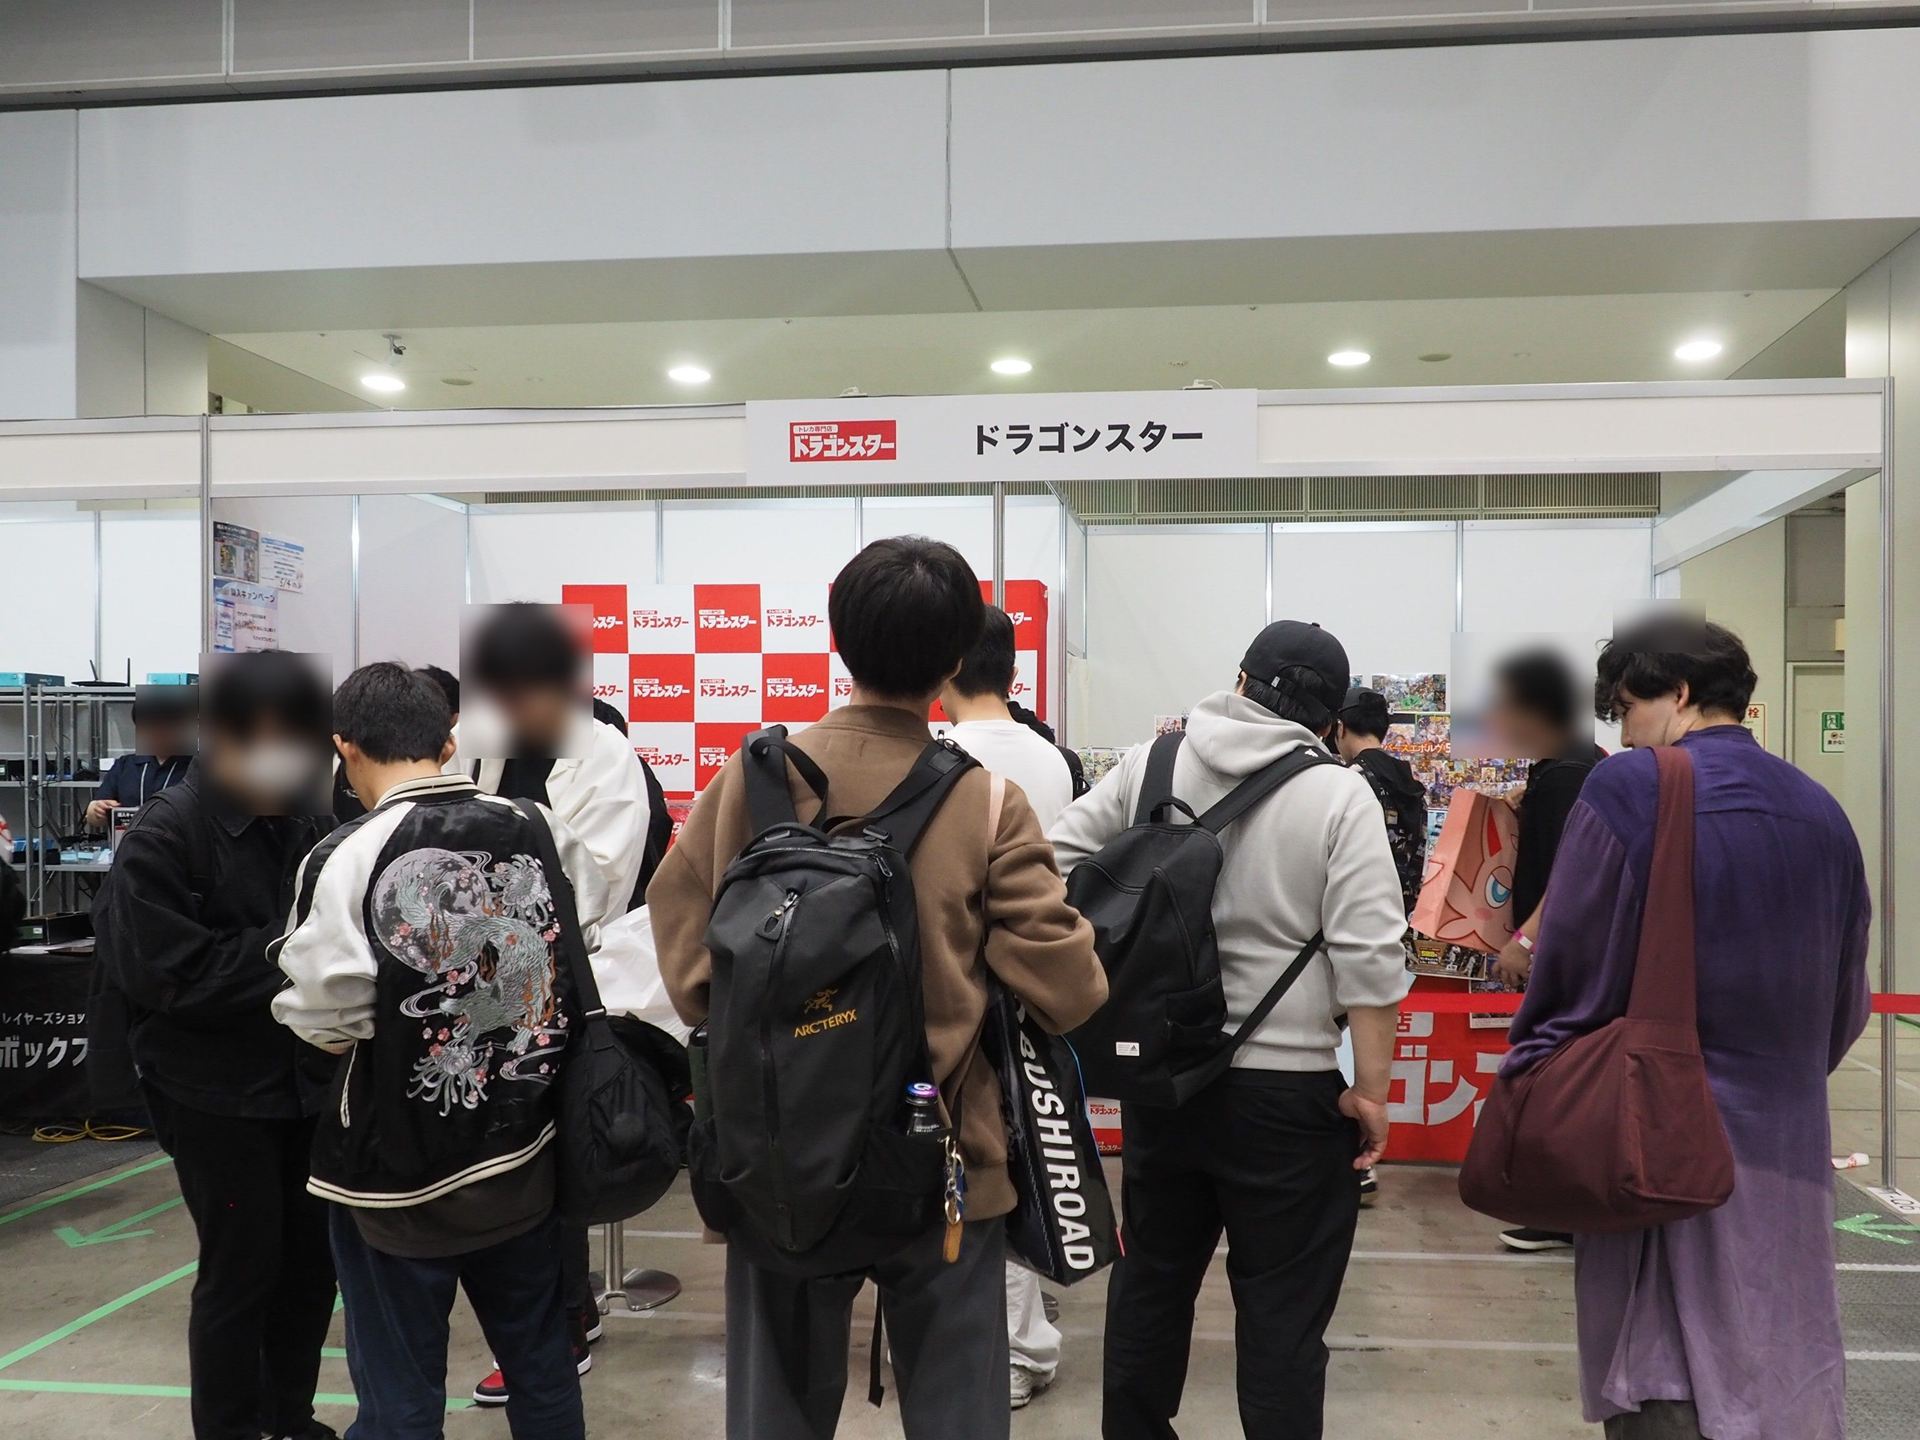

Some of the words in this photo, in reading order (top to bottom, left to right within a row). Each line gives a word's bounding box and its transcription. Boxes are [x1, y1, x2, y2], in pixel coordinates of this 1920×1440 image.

[798, 425, 833, 433] トレカ専門店
[977, 420, 1203, 455] ドラゴンスター
[794, 434, 895, 458] ドラゴンスター
[633, 615, 690, 629] ドラゴンスター
[699, 615, 757, 629] ドラゴンスター
[767, 615, 824, 628] ドラゴンスター
[633, 684, 691, 698] ドラゴンスター
[700, 684, 757, 697] ドラゴンスター
[767, 684, 824, 698] ドラゴンスター
[638, 753, 690, 766] ラゴンスター
[2, 1012, 88, 1025] レイヤーズショッ
[1020, 1030, 1095, 1270] BUSHIROAD
